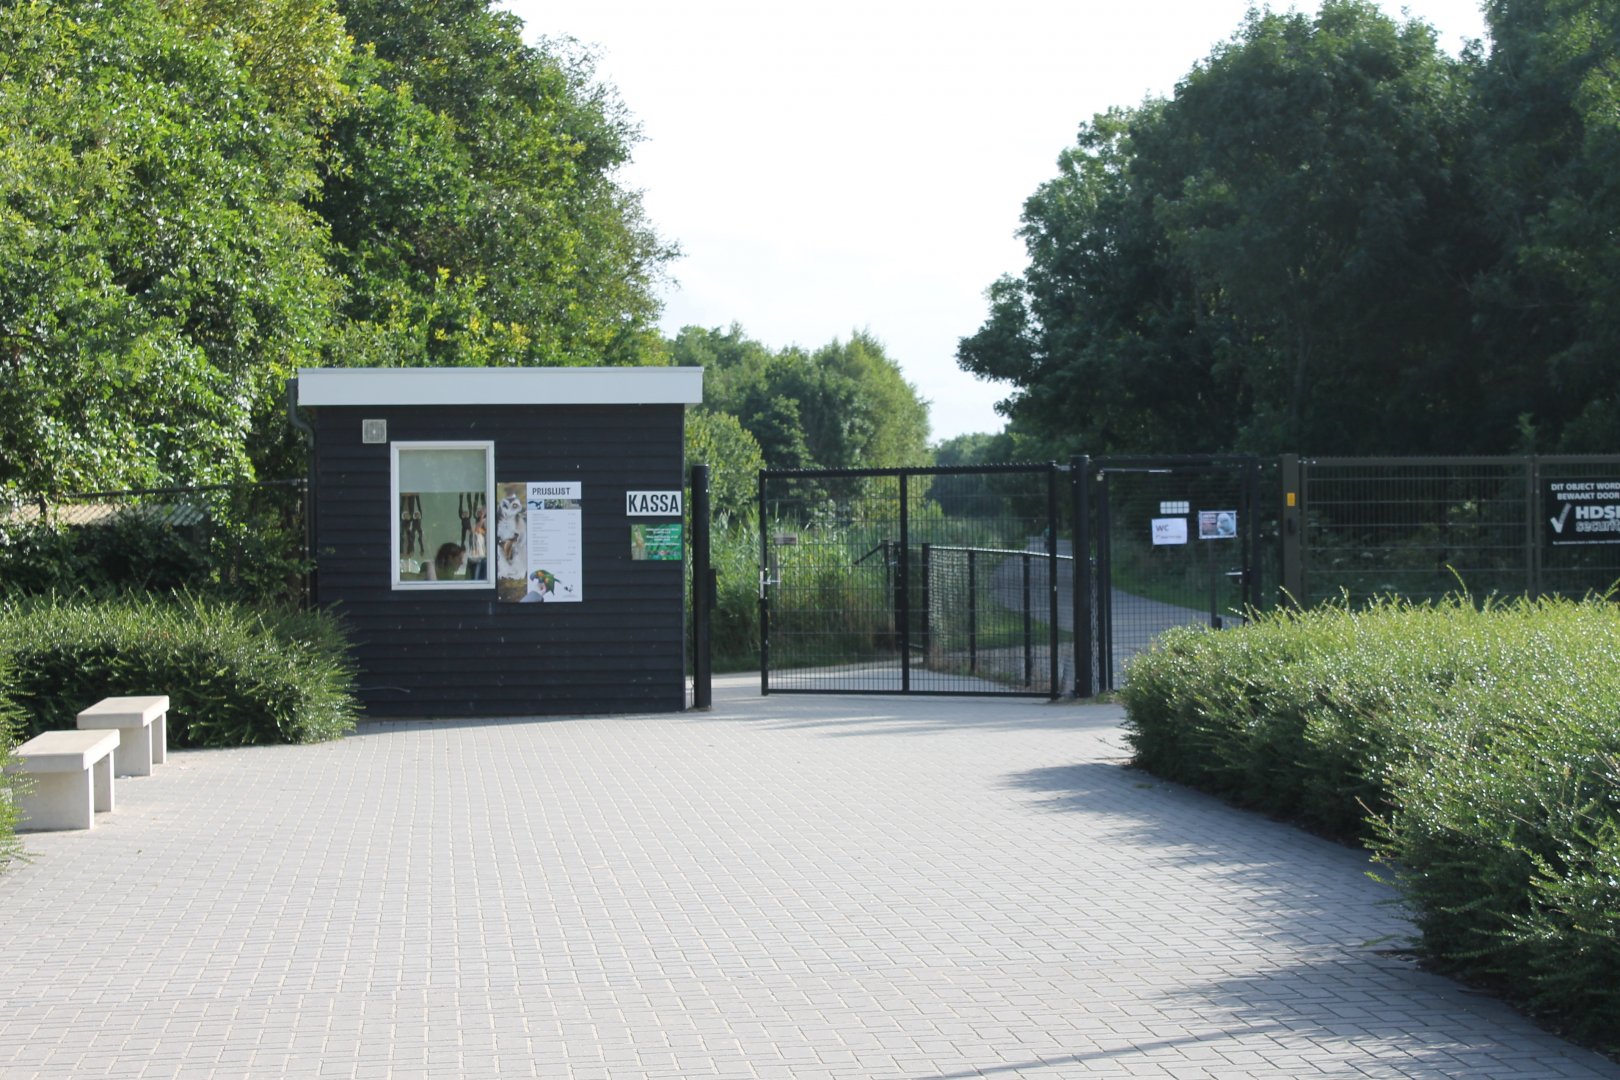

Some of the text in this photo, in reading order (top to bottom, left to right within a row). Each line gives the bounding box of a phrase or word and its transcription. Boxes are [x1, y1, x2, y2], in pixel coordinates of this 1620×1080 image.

[1551, 483, 1564, 491] DIT
[1566, 483, 1595, 491] OBJECT
[532, 487, 570, 496] PRIJSLIJST
[628, 494, 679, 513] KASSA
[1155, 524, 1169, 532] WC
